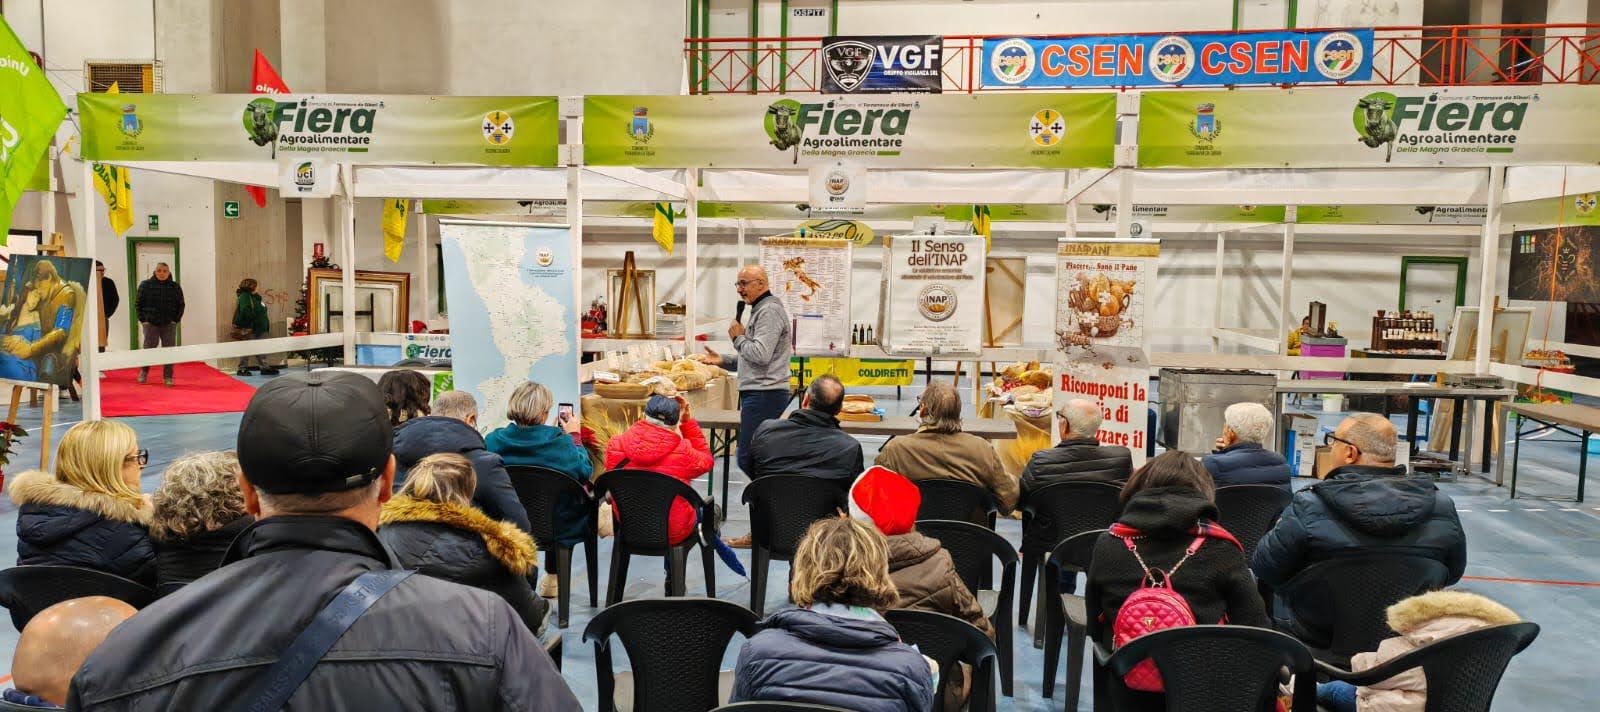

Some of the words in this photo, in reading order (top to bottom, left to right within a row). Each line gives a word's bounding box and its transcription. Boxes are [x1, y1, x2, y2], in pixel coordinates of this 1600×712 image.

[837, 47, 862, 56] VGF
[877, 45, 939, 69] VGF
[1201, 40, 1308, 75] CSEN
[1041, 44, 1144, 76] CSEN
[274, 100, 376, 133] Fiera
[799, 101, 911, 135] Fiera
[1392, 93, 1528, 131] Fiera
[280, 134, 370, 145] Agroalimentare
[803, 138, 902, 148] Agroalimentare
[1399, 132, 1517, 145] Agroalimentare
[1419, 146, 1449, 154] Magna
[912, 240, 919, 252] Il
[925, 240, 965, 252] Senso
[908, 254, 967, 266] dell'INAP
[926, 295, 947, 303] INAP
[858, 369, 908, 378] COLDIRETTI
[1061, 374, 1128, 399] Ricomponi
[1133, 383, 1145, 401] la
[1116, 405, 1128, 423] di
[1133, 430, 1143, 448] il
